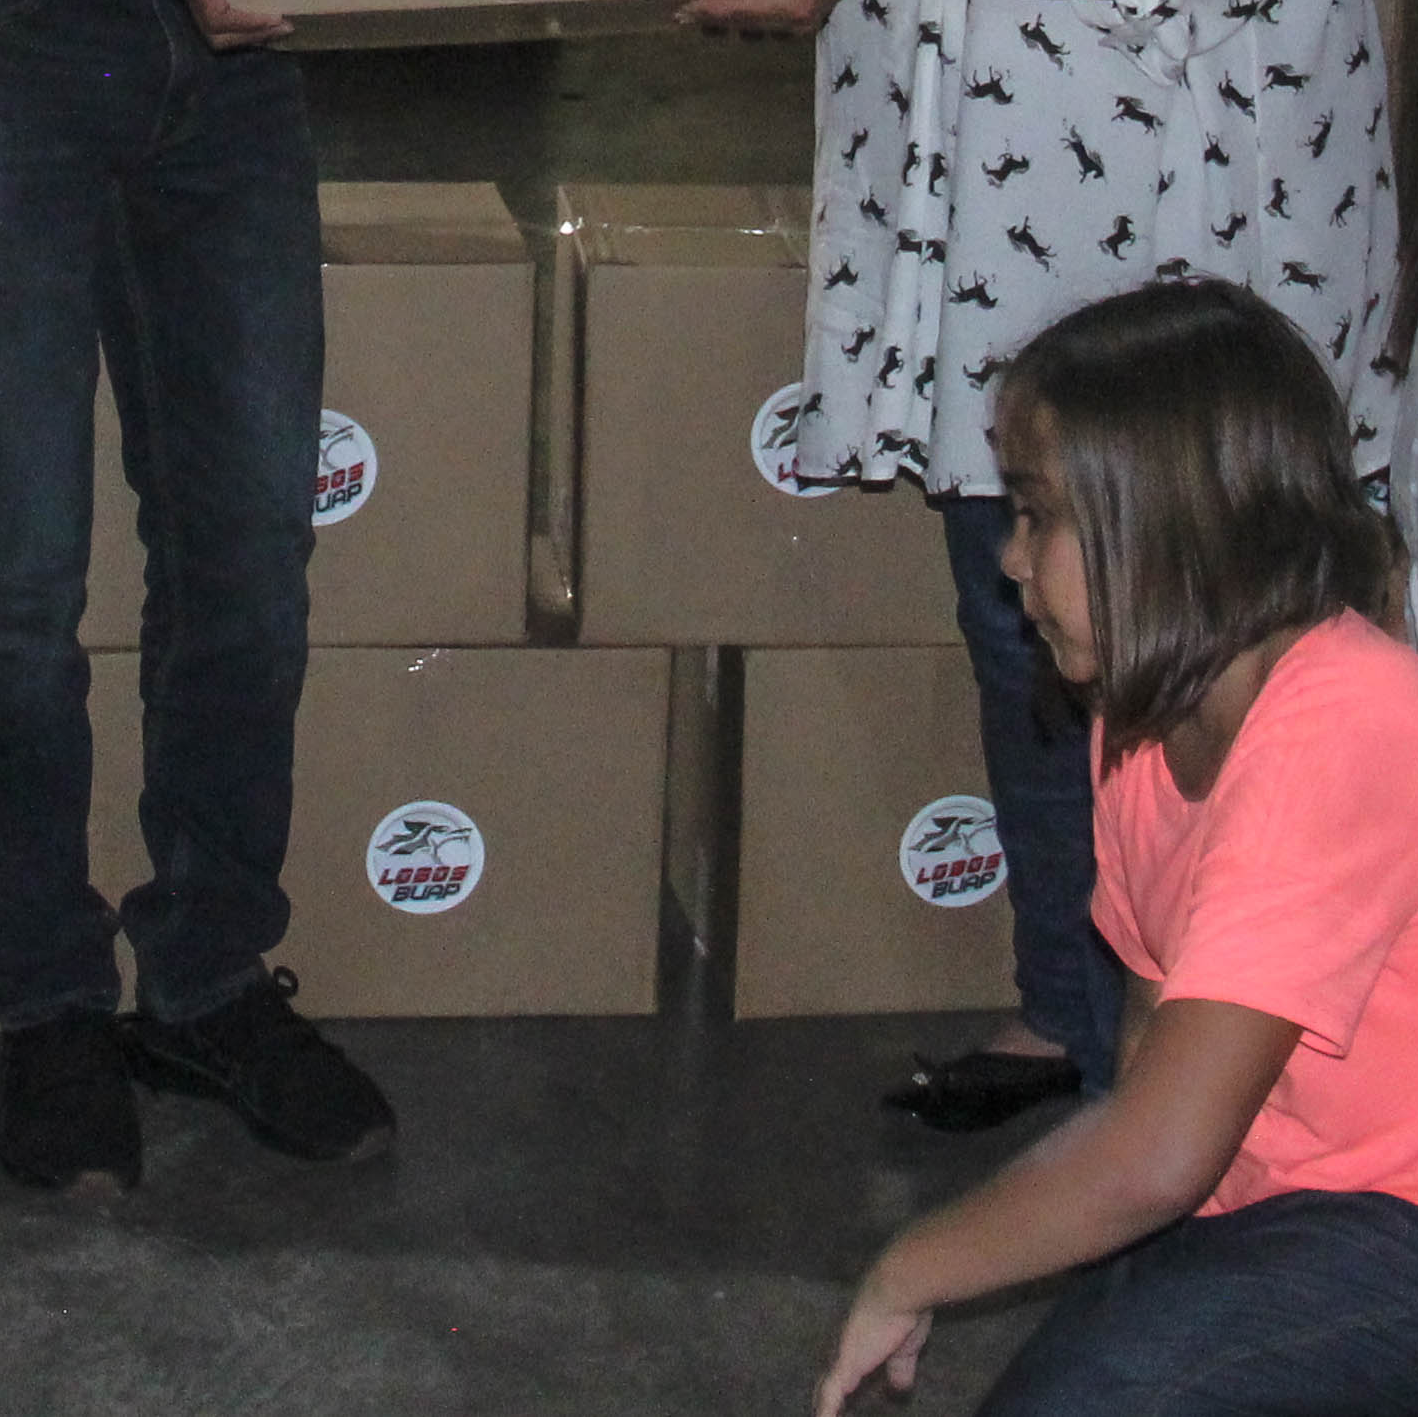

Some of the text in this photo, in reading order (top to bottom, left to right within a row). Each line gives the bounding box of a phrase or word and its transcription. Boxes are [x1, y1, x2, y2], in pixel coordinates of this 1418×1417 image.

[316, 483, 362, 513] UAP
[378, 865, 469, 885] LOBOS
[917, 852, 1003, 884] LOBOS
[391, 883, 461, 902] BUAP
[932, 871, 996, 898] BUAP
